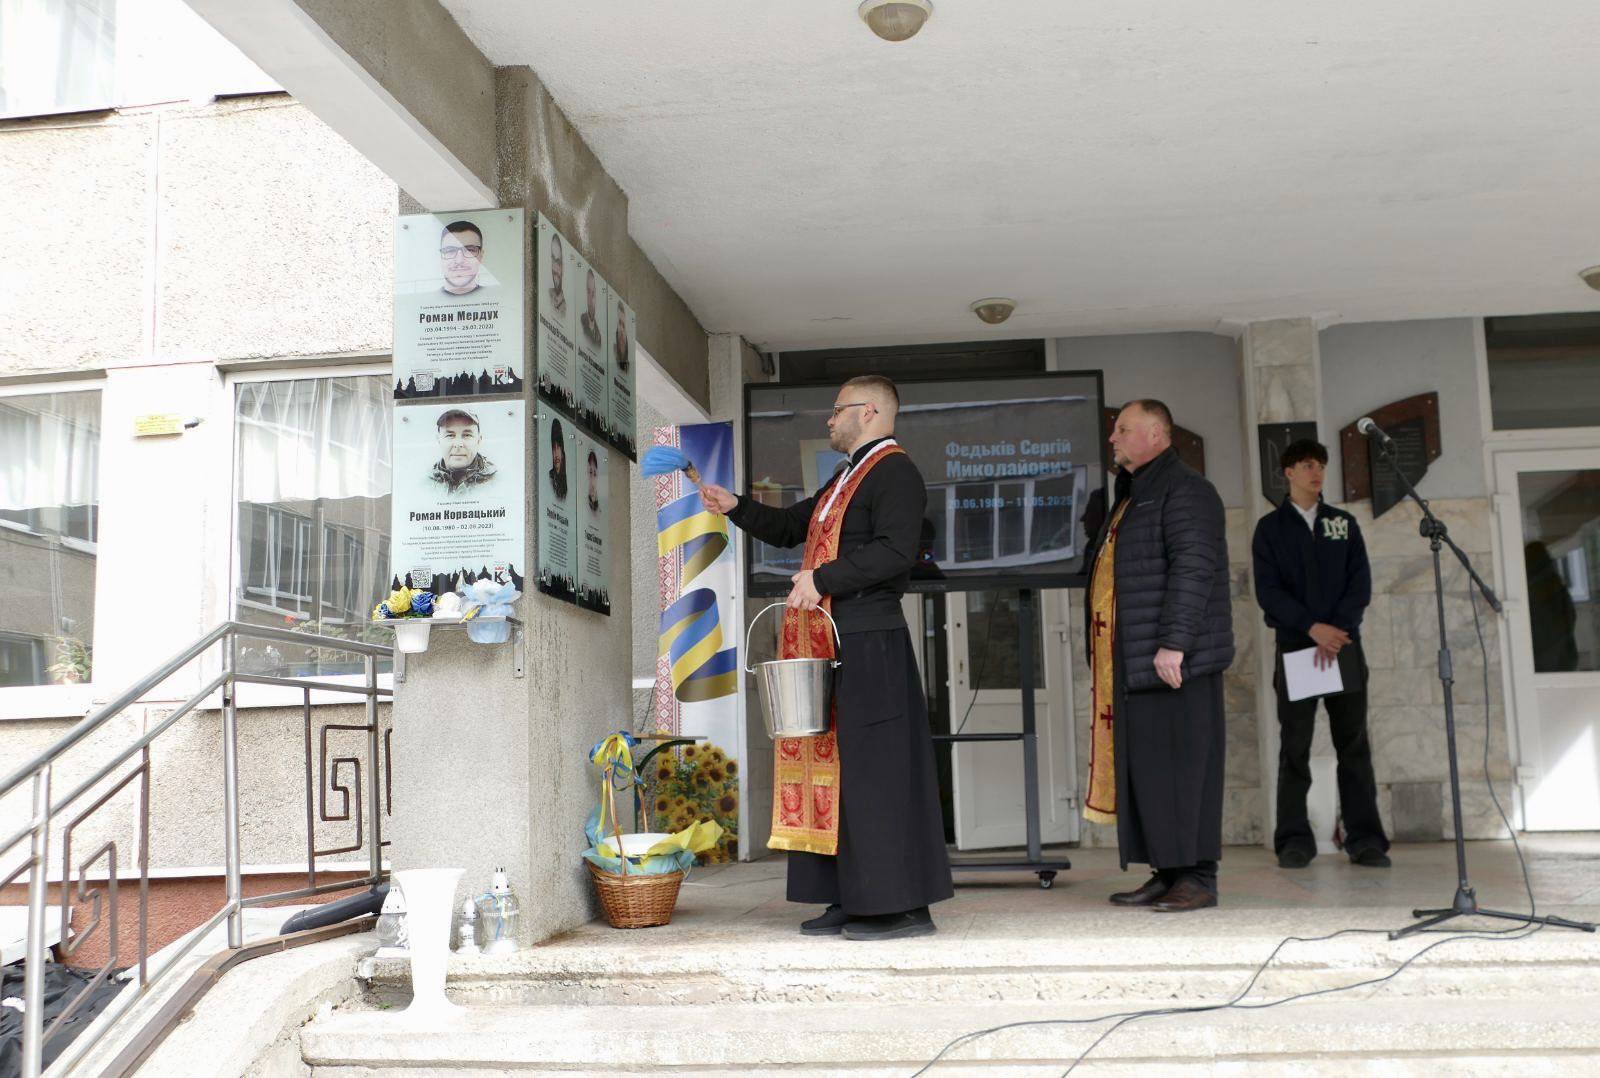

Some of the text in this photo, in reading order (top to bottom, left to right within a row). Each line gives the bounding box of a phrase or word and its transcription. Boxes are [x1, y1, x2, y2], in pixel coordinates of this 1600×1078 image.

[419, 310, 499, 324] Роман Мердух
[945, 438, 1071, 459] Федьків Сергій
[945, 458, 1073, 478] Миколайович
[409, 506, 506, 522] Роман Корвацький
